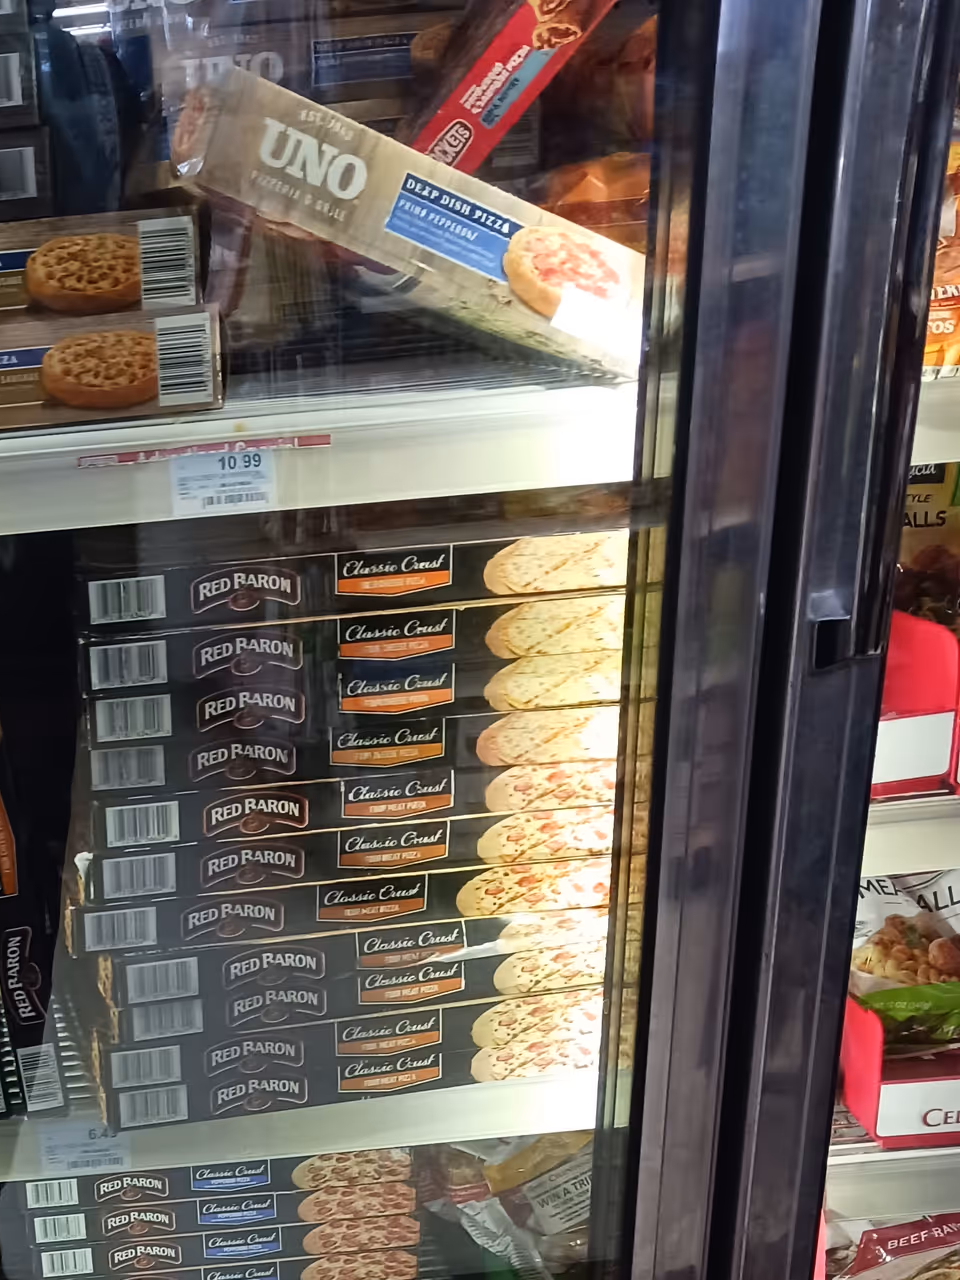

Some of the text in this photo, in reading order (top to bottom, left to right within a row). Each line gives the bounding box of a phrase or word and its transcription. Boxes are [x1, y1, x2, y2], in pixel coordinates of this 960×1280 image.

[259, 117, 367, 200] UNO
[406, 179, 510, 233] DEEP DISH PIZZA
[217, 453, 262, 470] 10.99
[343, 554, 445, 577] Classic Crust
[199, 573, 291, 601] RED BARON
[345, 618, 449, 641] Classic Crust
[200, 637, 293, 666] RED BARON
[348, 778, 448, 801] Classic Crust
[211, 798, 300, 826] RED BARON
[345, 1054, 435, 1078] Classic Crust
[217, 1079, 299, 1105] RED BARON
[922, 1108, 960, 1127] CE
[196, 1165, 266, 1180] Classic Crust
[571, 1177, 590, 1190] TRI
[100, 1177, 162, 1195] RED BARON
[887, 1230, 928, 1249] BEEF
